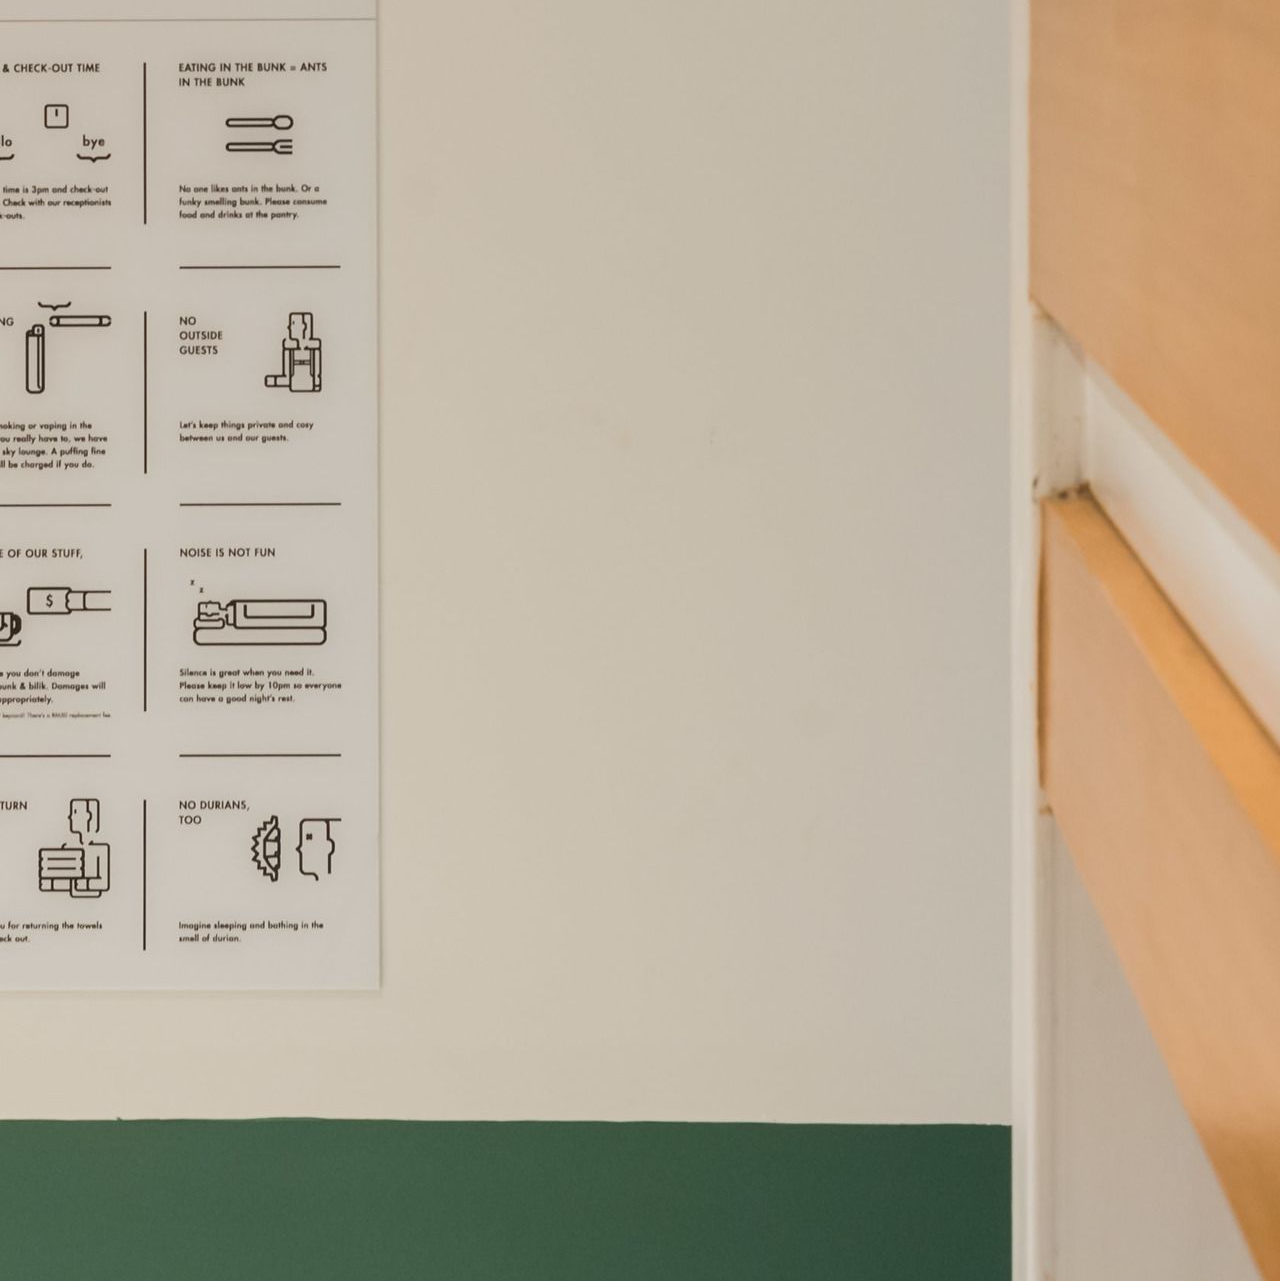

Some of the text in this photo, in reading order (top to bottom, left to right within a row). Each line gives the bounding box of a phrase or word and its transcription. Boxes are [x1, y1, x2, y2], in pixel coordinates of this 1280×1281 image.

[2, 64, 10, 73] &
[14, 63, 73, 73] CHECK-OUT
[77, 63, 100, 72] TIME
[179, 62, 216, 72] EATING
[220, 63, 231, 72] IN
[235, 62, 253, 72] THE
[257, 62, 286, 72] BUNK
[300, 62, 327, 72] ANTS
[179, 77, 245, 86] IN THE BUNK
[83, 134, 105, 150] bye
[3, 185, 20, 194] time
[22, 186, 29, 194] is
[32, 185, 49, 195] 3pm
[52, 185, 67, 194] and
[179, 185, 191, 193] No
[211, 184, 229, 193] likes
[231, 185, 248, 193] ants
[251, 184, 258, 193] in
[261, 184, 273, 193] the
[301, 184, 311, 193] Or
[180, 316, 196, 326] NO
[179, 331, 222, 340] OUTSIDE
[179, 345, 218, 355] GUESTS
[39, 422, 67, 432] vaping
[80, 421, 92, 429] the
[199, 420, 218, 430] keep
[221, 420, 245, 431] things
[248, 421, 276, 430] private
[278, 420, 294, 428] and
[296, 422, 314, 430] cosy
[180, 433, 213, 442] between
[227, 433, 243, 442] and
[8, 549, 21, 558] OF
[25, 549, 48, 558] OUR
[52, 548, 82, 559] STUFF,
[180, 547, 275, 558] NOISE IS NOT FUN
[6, 671, 21, 680] you
[47, 668, 80, 679] damage
[180, 668, 207, 676] Silence
[210, 668, 216, 676] is
[219, 670, 240, 679] great
[243, 667, 264, 676] when
[267, 670, 282, 678] you
[285, 667, 304, 676] need
[179, 800, 250, 811] NO DURIANS,
[179, 815, 202, 825] TOO
[8, 921, 19, 930] for
[22, 922, 59, 932] returning
[62, 921, 74, 929] the
[77, 921, 102, 929] towels
[179, 920, 324, 932] Imagine sleeping and bathing in the
